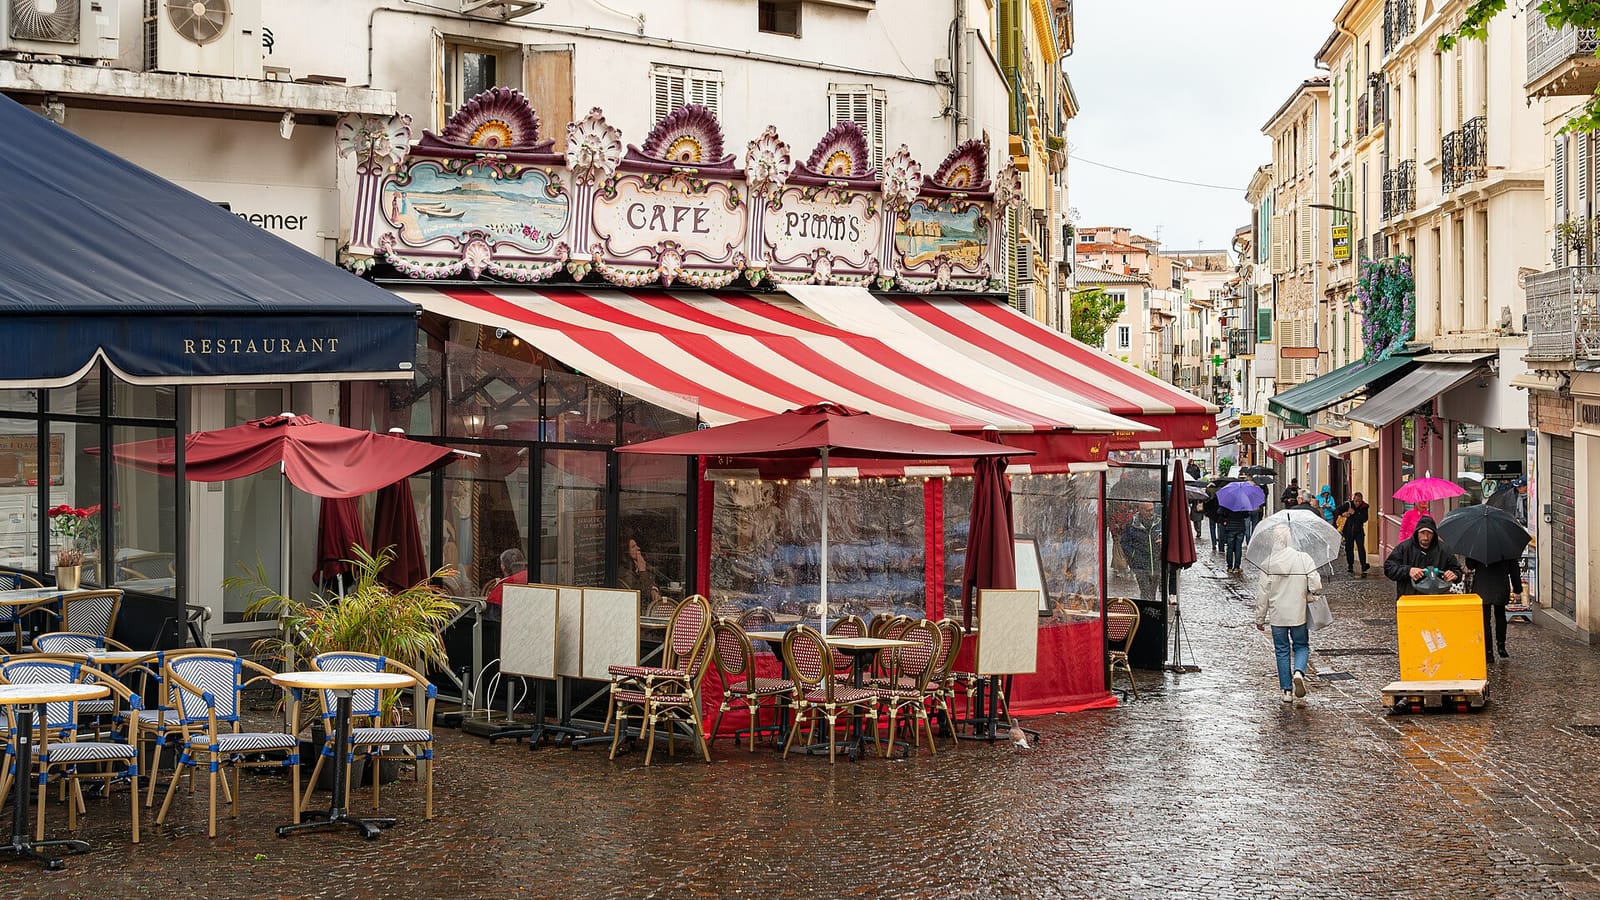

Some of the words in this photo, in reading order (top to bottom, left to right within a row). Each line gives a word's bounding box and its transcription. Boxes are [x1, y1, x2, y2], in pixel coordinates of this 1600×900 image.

[626, 202, 710, 234] CAFÉ
[785, 212, 860, 242] PIMM'S
[183, 338, 340, 355] RESTAURANT
